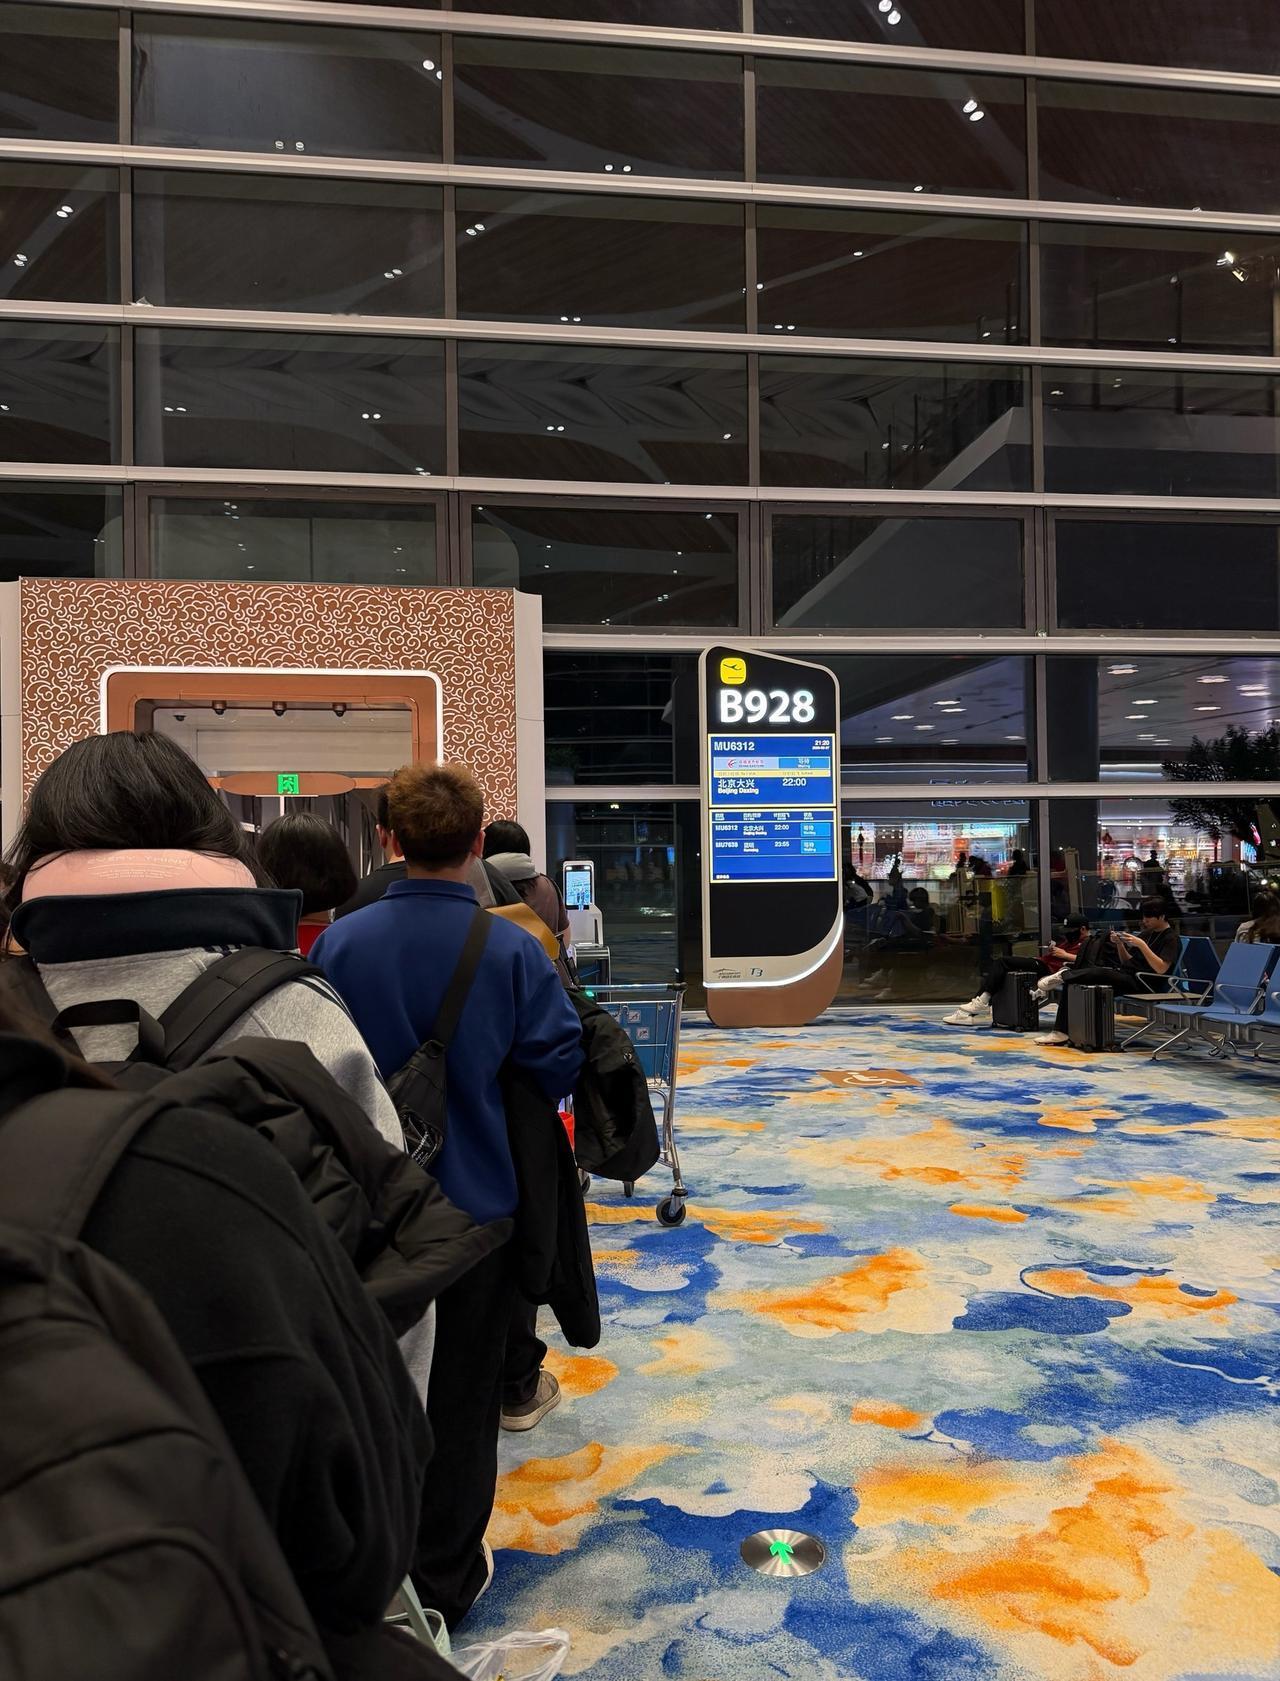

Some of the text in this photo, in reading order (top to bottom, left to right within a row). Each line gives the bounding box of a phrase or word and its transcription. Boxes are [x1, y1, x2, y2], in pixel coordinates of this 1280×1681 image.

[720, 689, 815, 723] B928
[714, 741, 755, 751] MU6312
[718, 779, 755, 788] 北京大兴
[782, 778, 807, 787] 22:00
